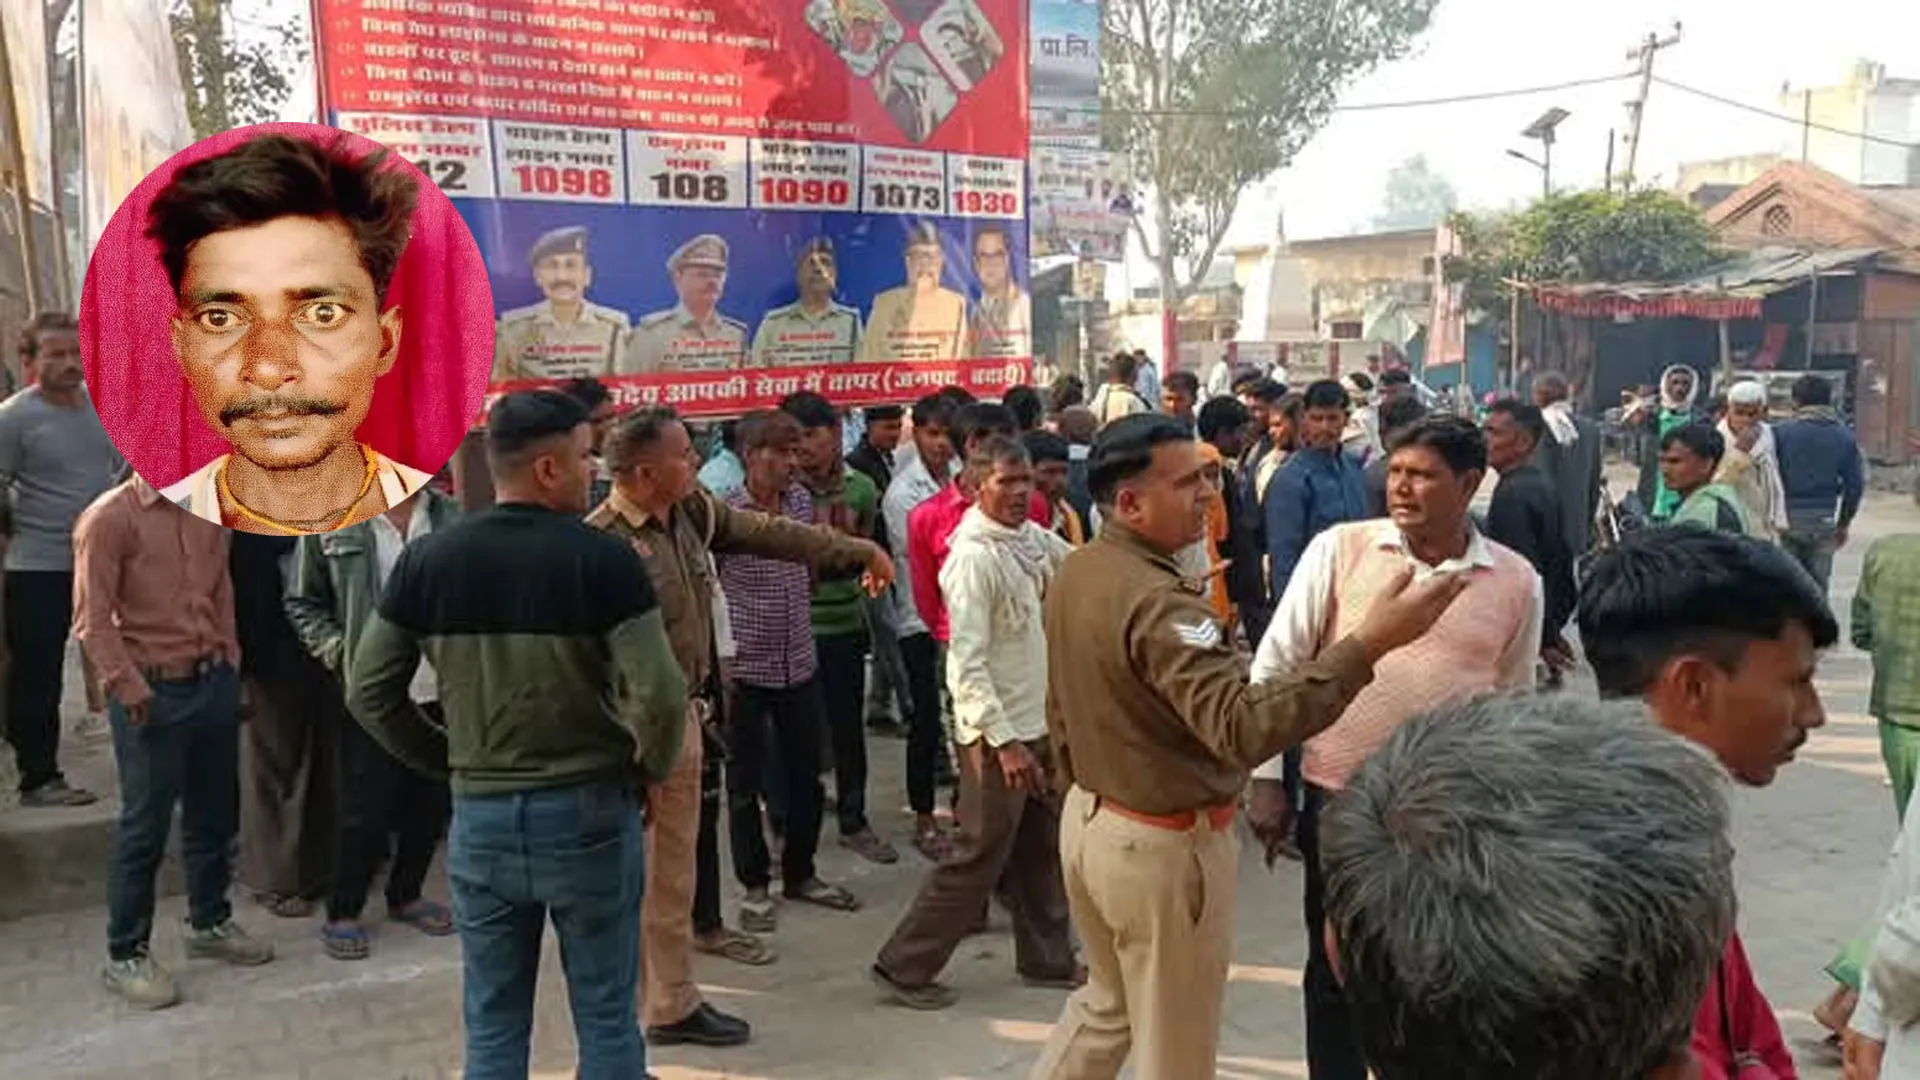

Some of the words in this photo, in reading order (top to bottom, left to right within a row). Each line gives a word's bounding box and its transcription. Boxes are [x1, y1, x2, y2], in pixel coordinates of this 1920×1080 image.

[414, 160, 468, 190] 12
[511, 165, 613, 198] 1098
[650, 172, 729, 202] 108
[756, 177, 849, 205] 1090
[870, 184, 941, 210] 1073
[952, 191, 1018, 214] 1930
